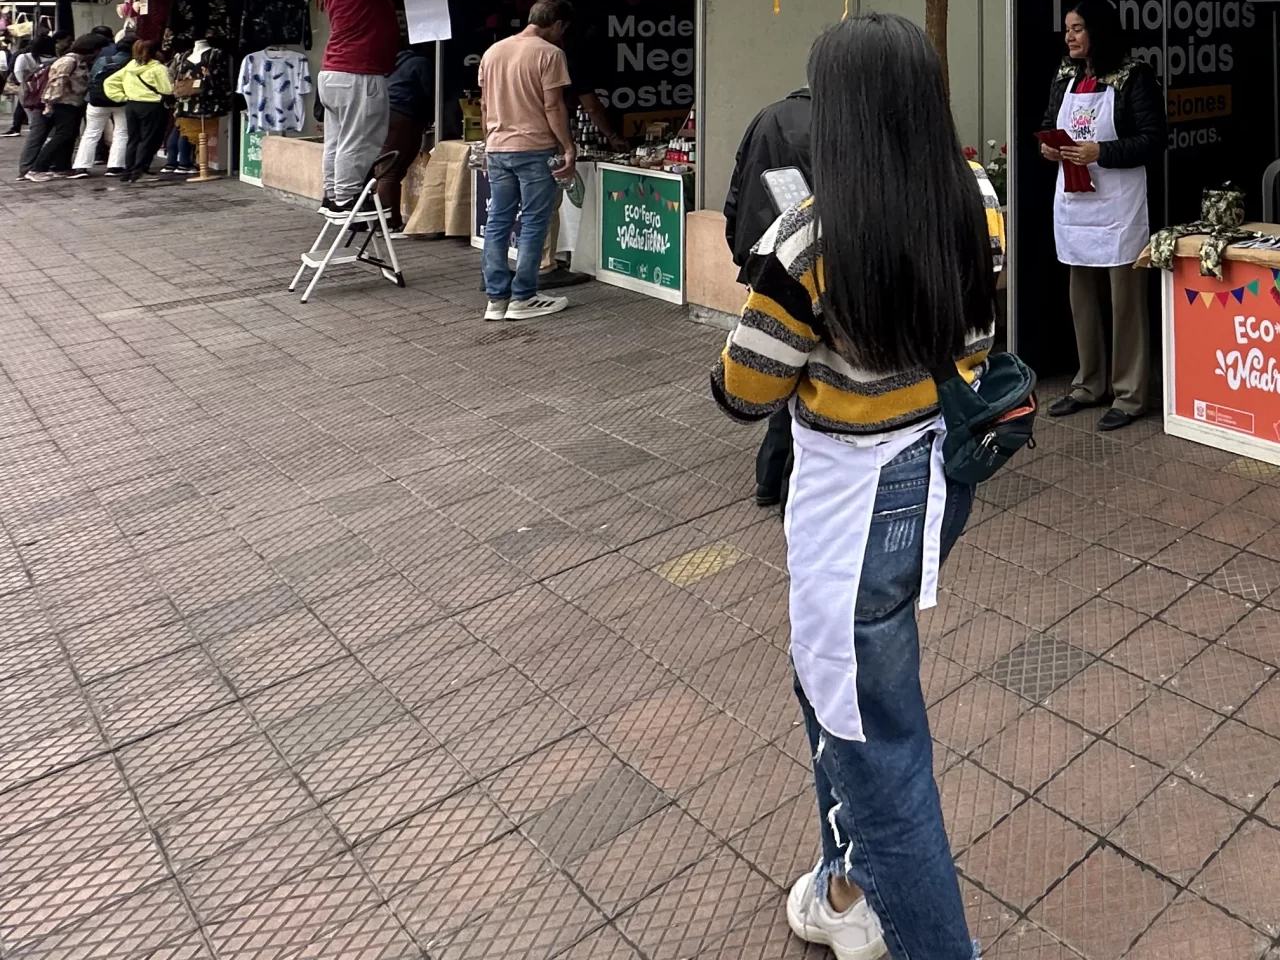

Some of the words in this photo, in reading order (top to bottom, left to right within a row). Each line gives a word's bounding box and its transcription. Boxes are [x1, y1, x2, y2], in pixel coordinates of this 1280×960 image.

[608, 15, 693, 39] Mode
[617, 43, 693, 77] Neg
[1131, 36, 1234, 85] mpias
[594, 80, 693, 109] soste
[1167, 93, 1226, 117] ciones
[1167, 127, 1222, 150] doras.
